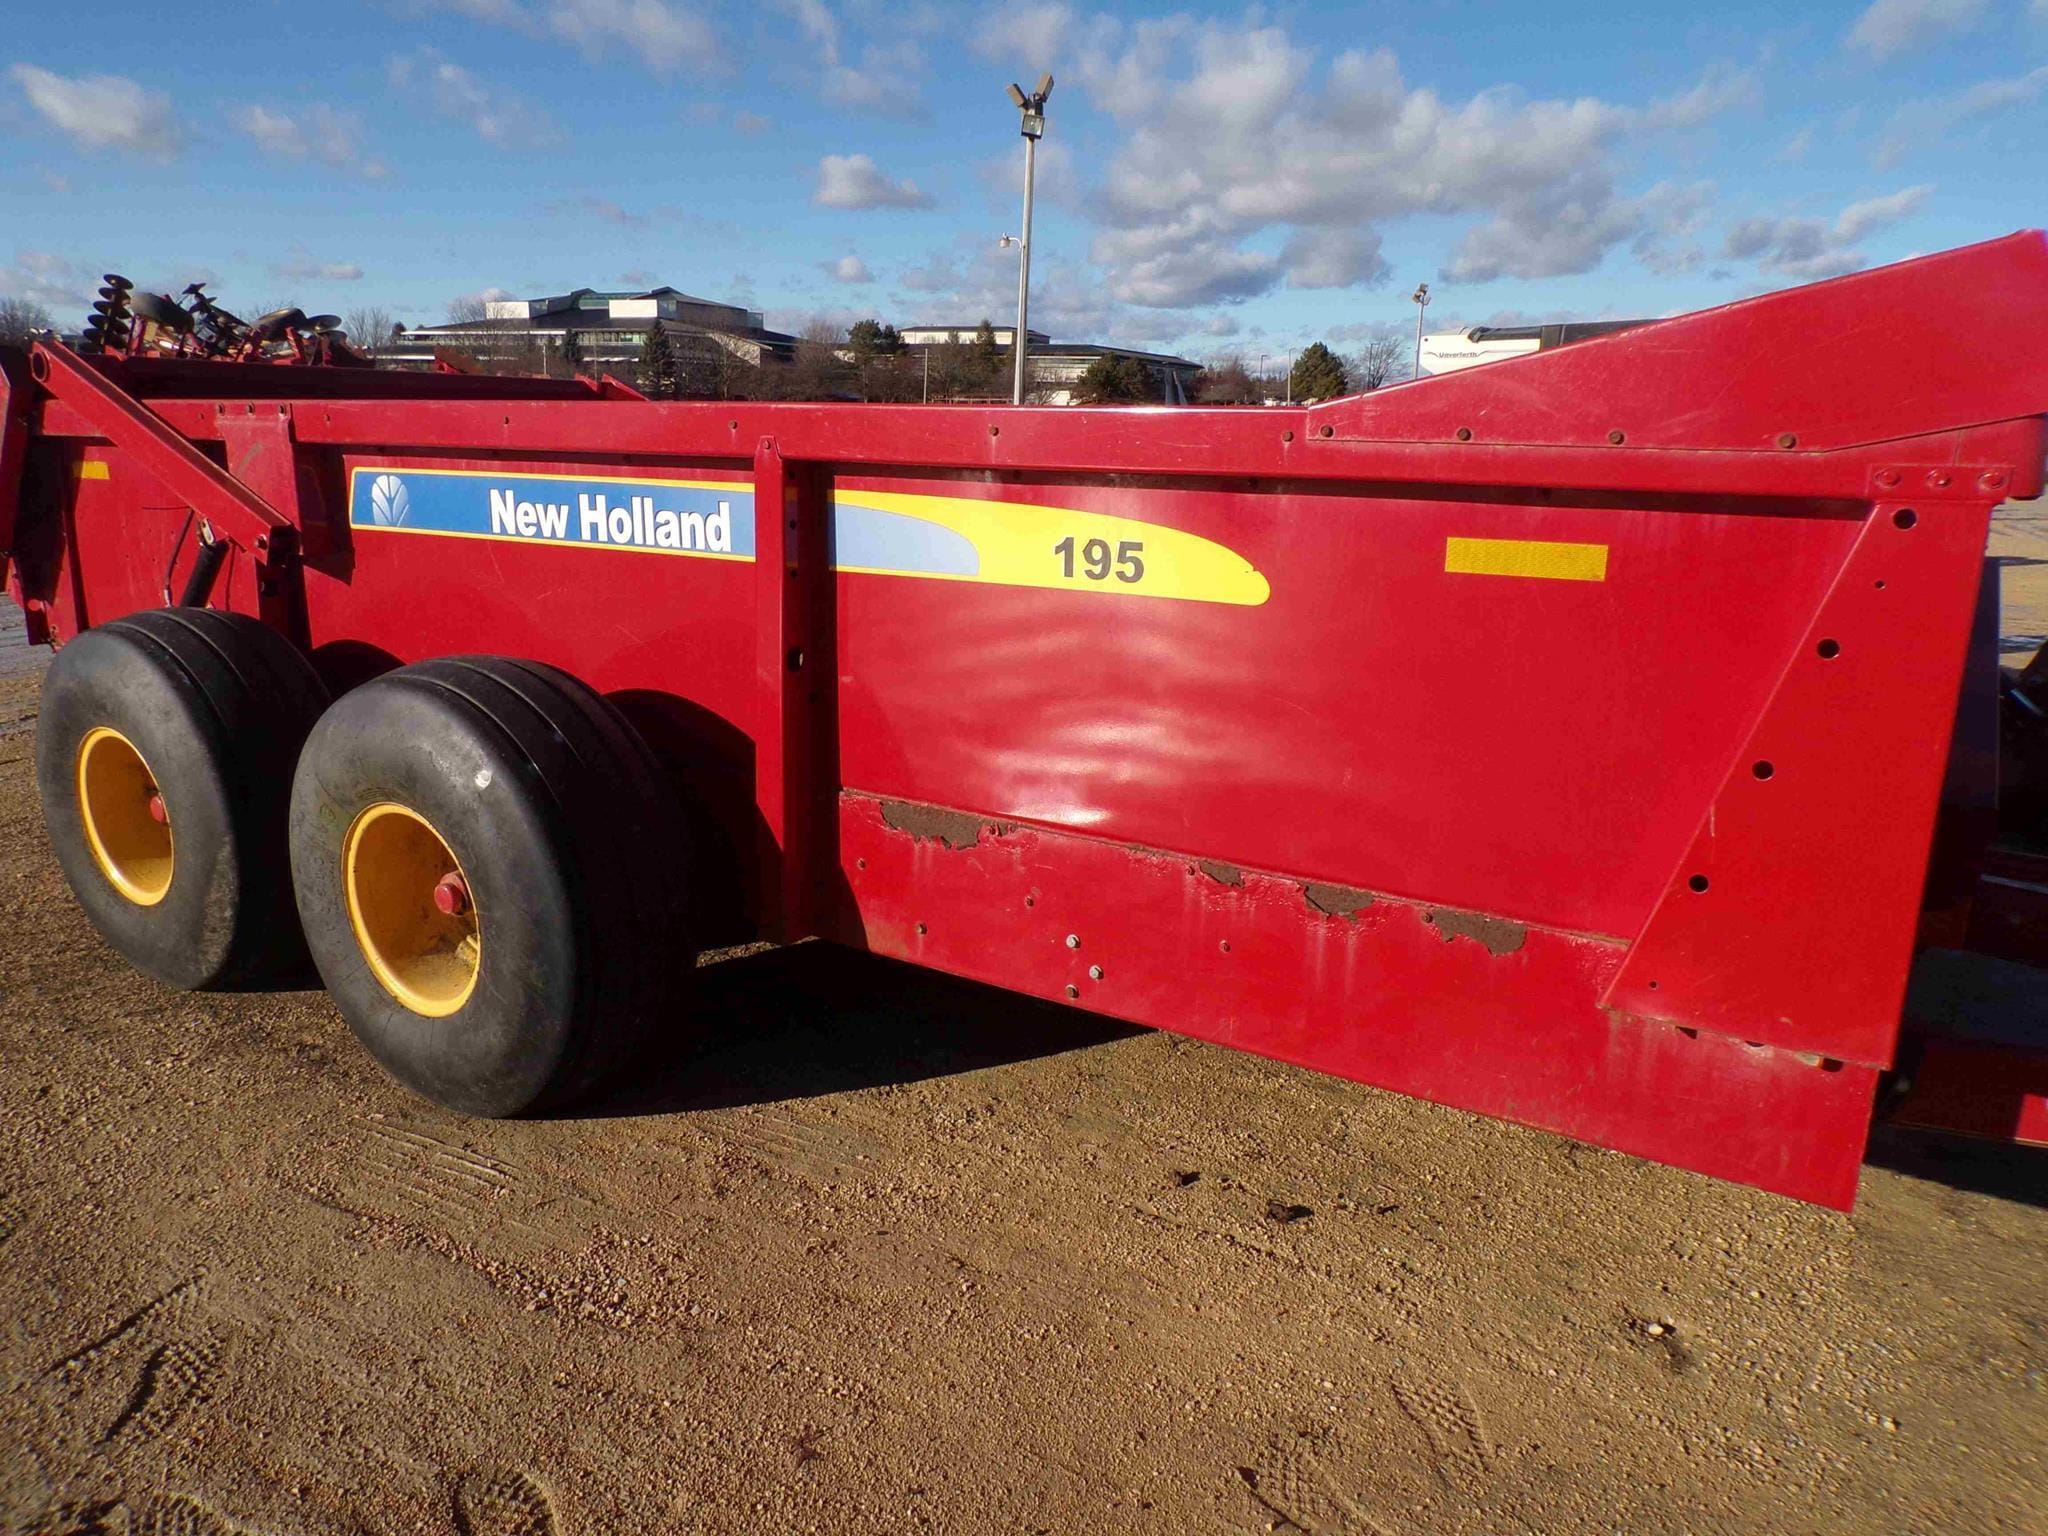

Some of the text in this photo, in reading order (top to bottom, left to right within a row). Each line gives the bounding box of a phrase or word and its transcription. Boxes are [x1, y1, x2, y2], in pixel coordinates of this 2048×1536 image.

[489, 488, 731, 552] New Holland
[1054, 537, 1144, 583] 195
